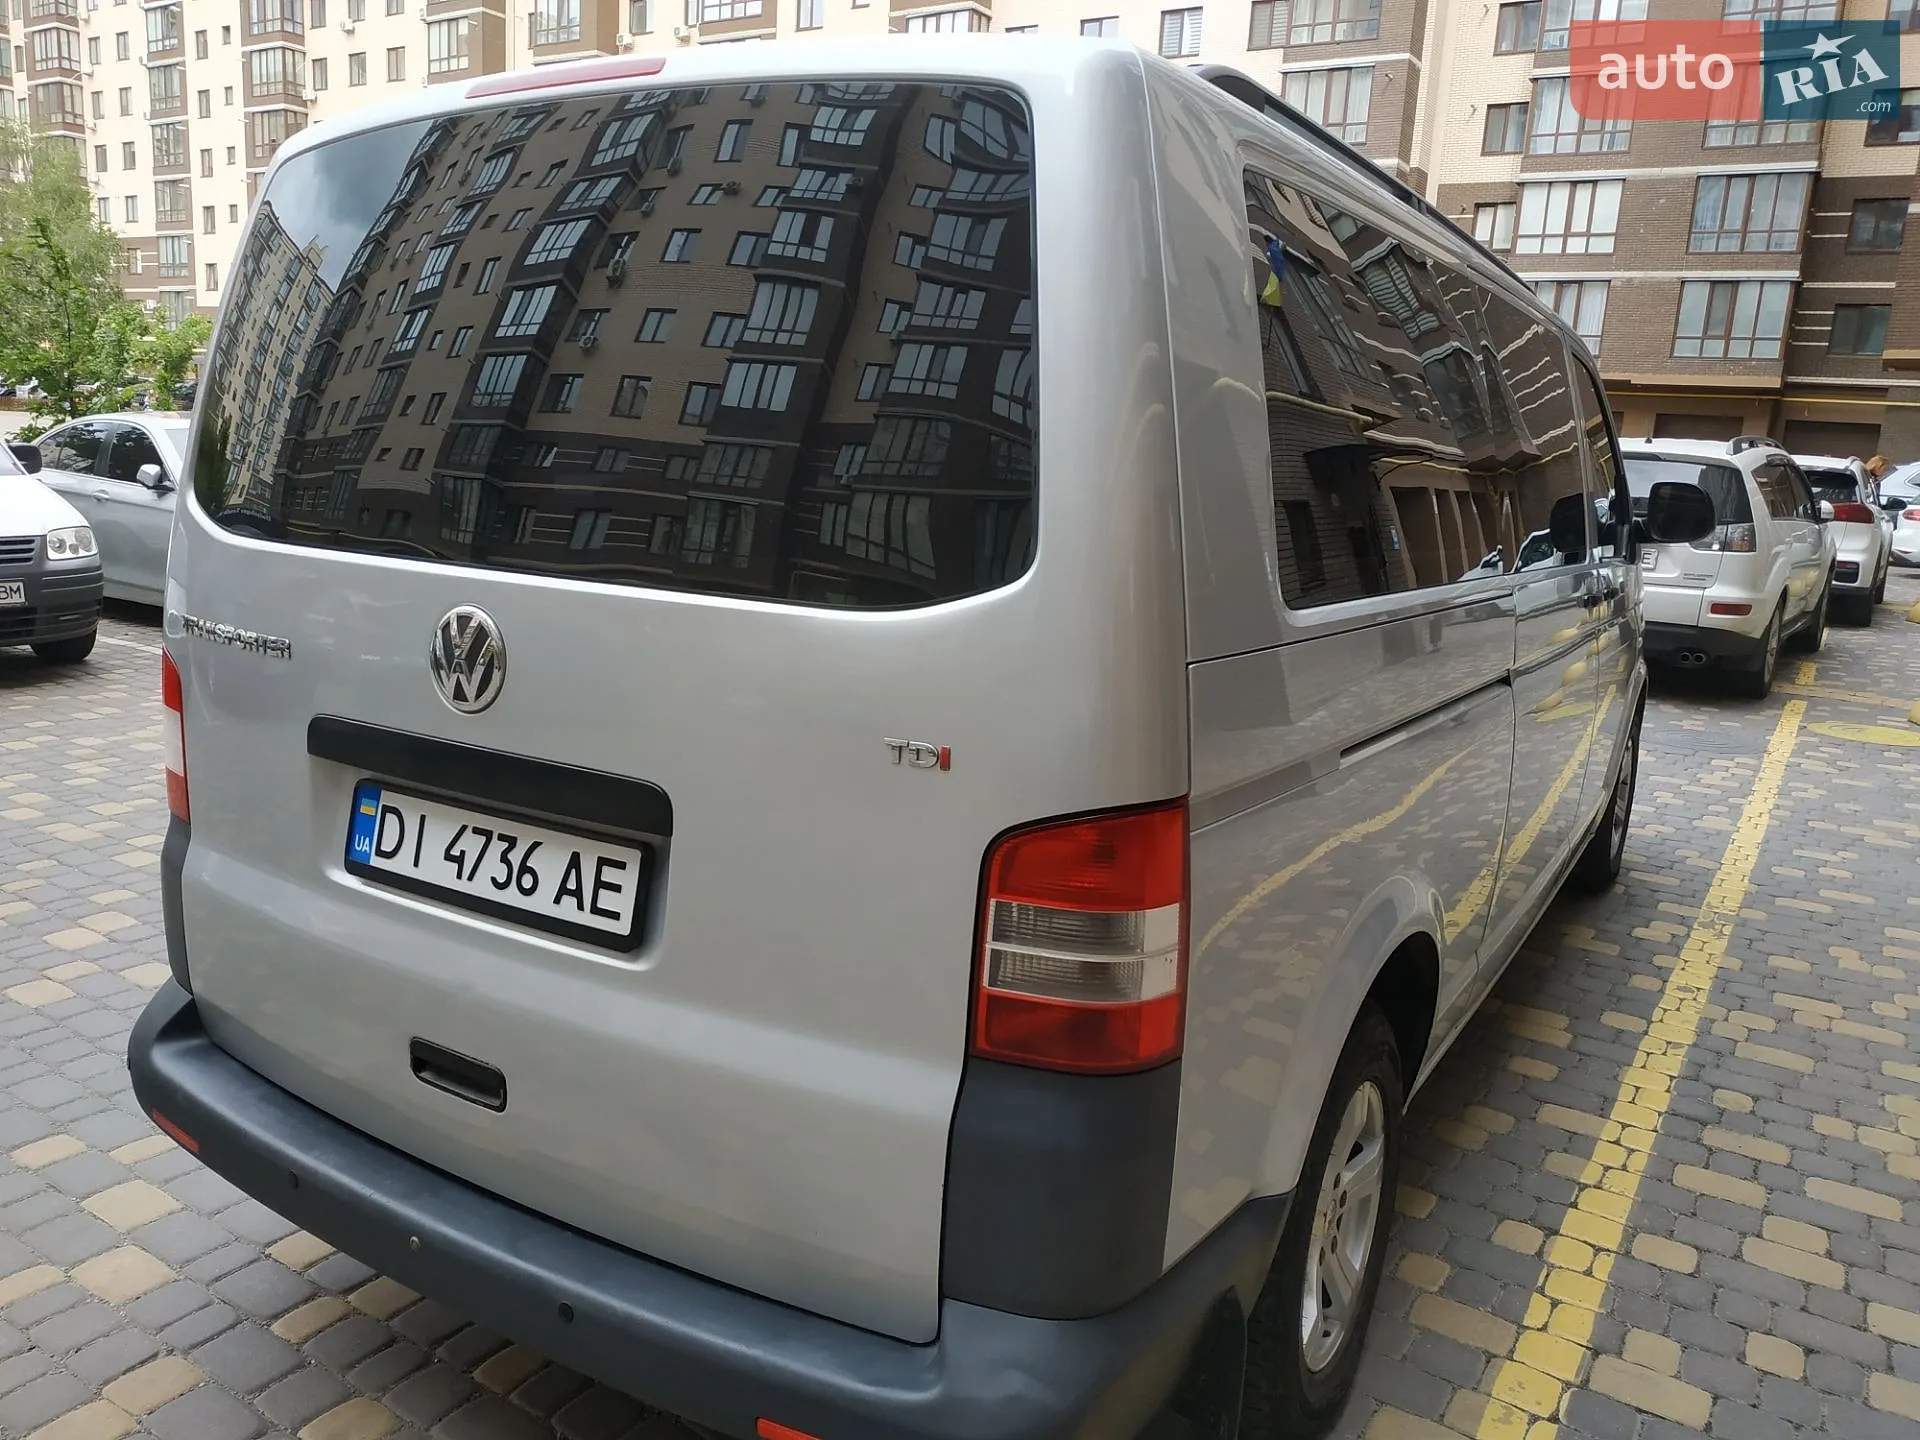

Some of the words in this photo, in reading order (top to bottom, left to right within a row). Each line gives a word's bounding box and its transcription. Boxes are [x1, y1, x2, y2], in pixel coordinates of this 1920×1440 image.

[435, 611, 497, 704] VW
[883, 737, 952, 771] TDI
[354, 834, 370, 854] UA
[374, 804, 426, 868] DI
[443, 824, 544, 896] 4736
[552, 851, 627, 921] AE
